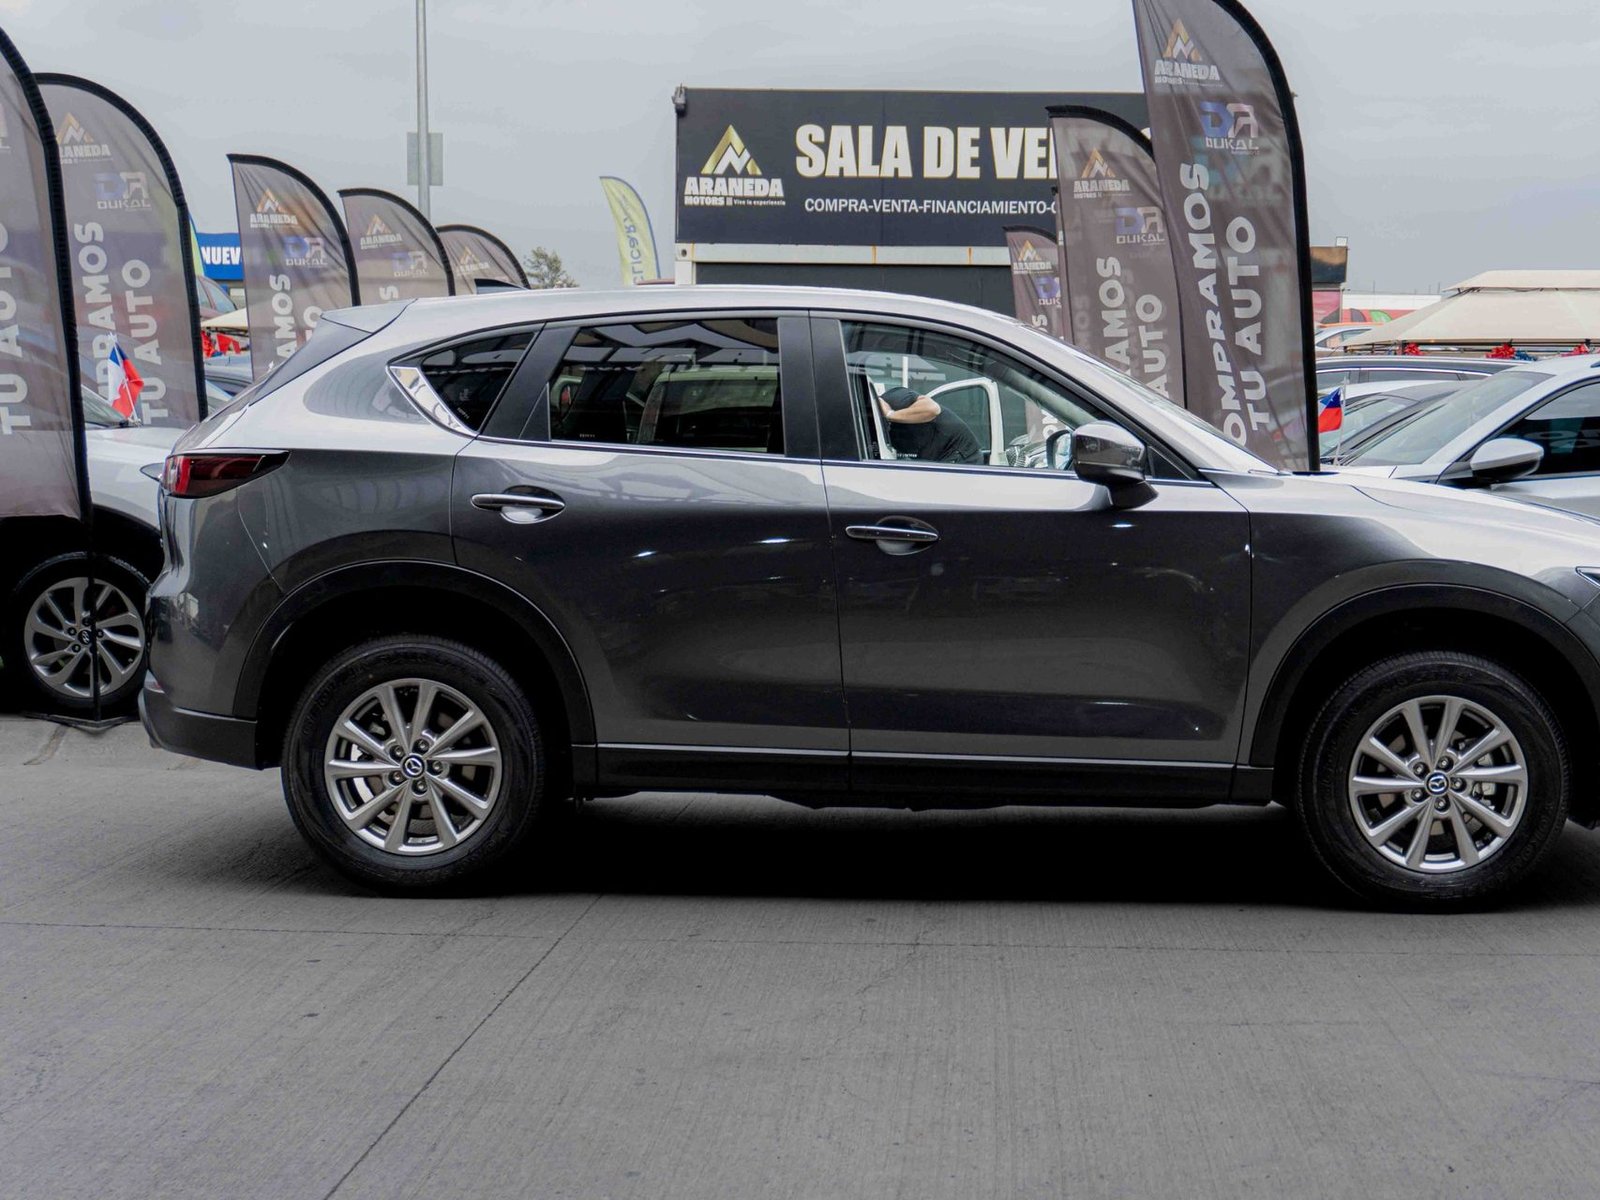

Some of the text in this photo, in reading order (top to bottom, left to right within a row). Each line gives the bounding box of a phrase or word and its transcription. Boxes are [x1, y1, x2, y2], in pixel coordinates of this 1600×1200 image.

[795, 124, 913, 178] SALA
[923, 126, 981, 179] DE
[1205, 137, 1260, 150] DUKAL
[684, 177, 785, 197] ARANEDA
[684, 195, 725, 206] MOTORS
[1073, 179, 1130, 192] ARANEDA
[121, 259, 169, 425] TU AUTO
[1226, 216, 1270, 431] TU AUTO
[0, 373, 32, 435] TU
